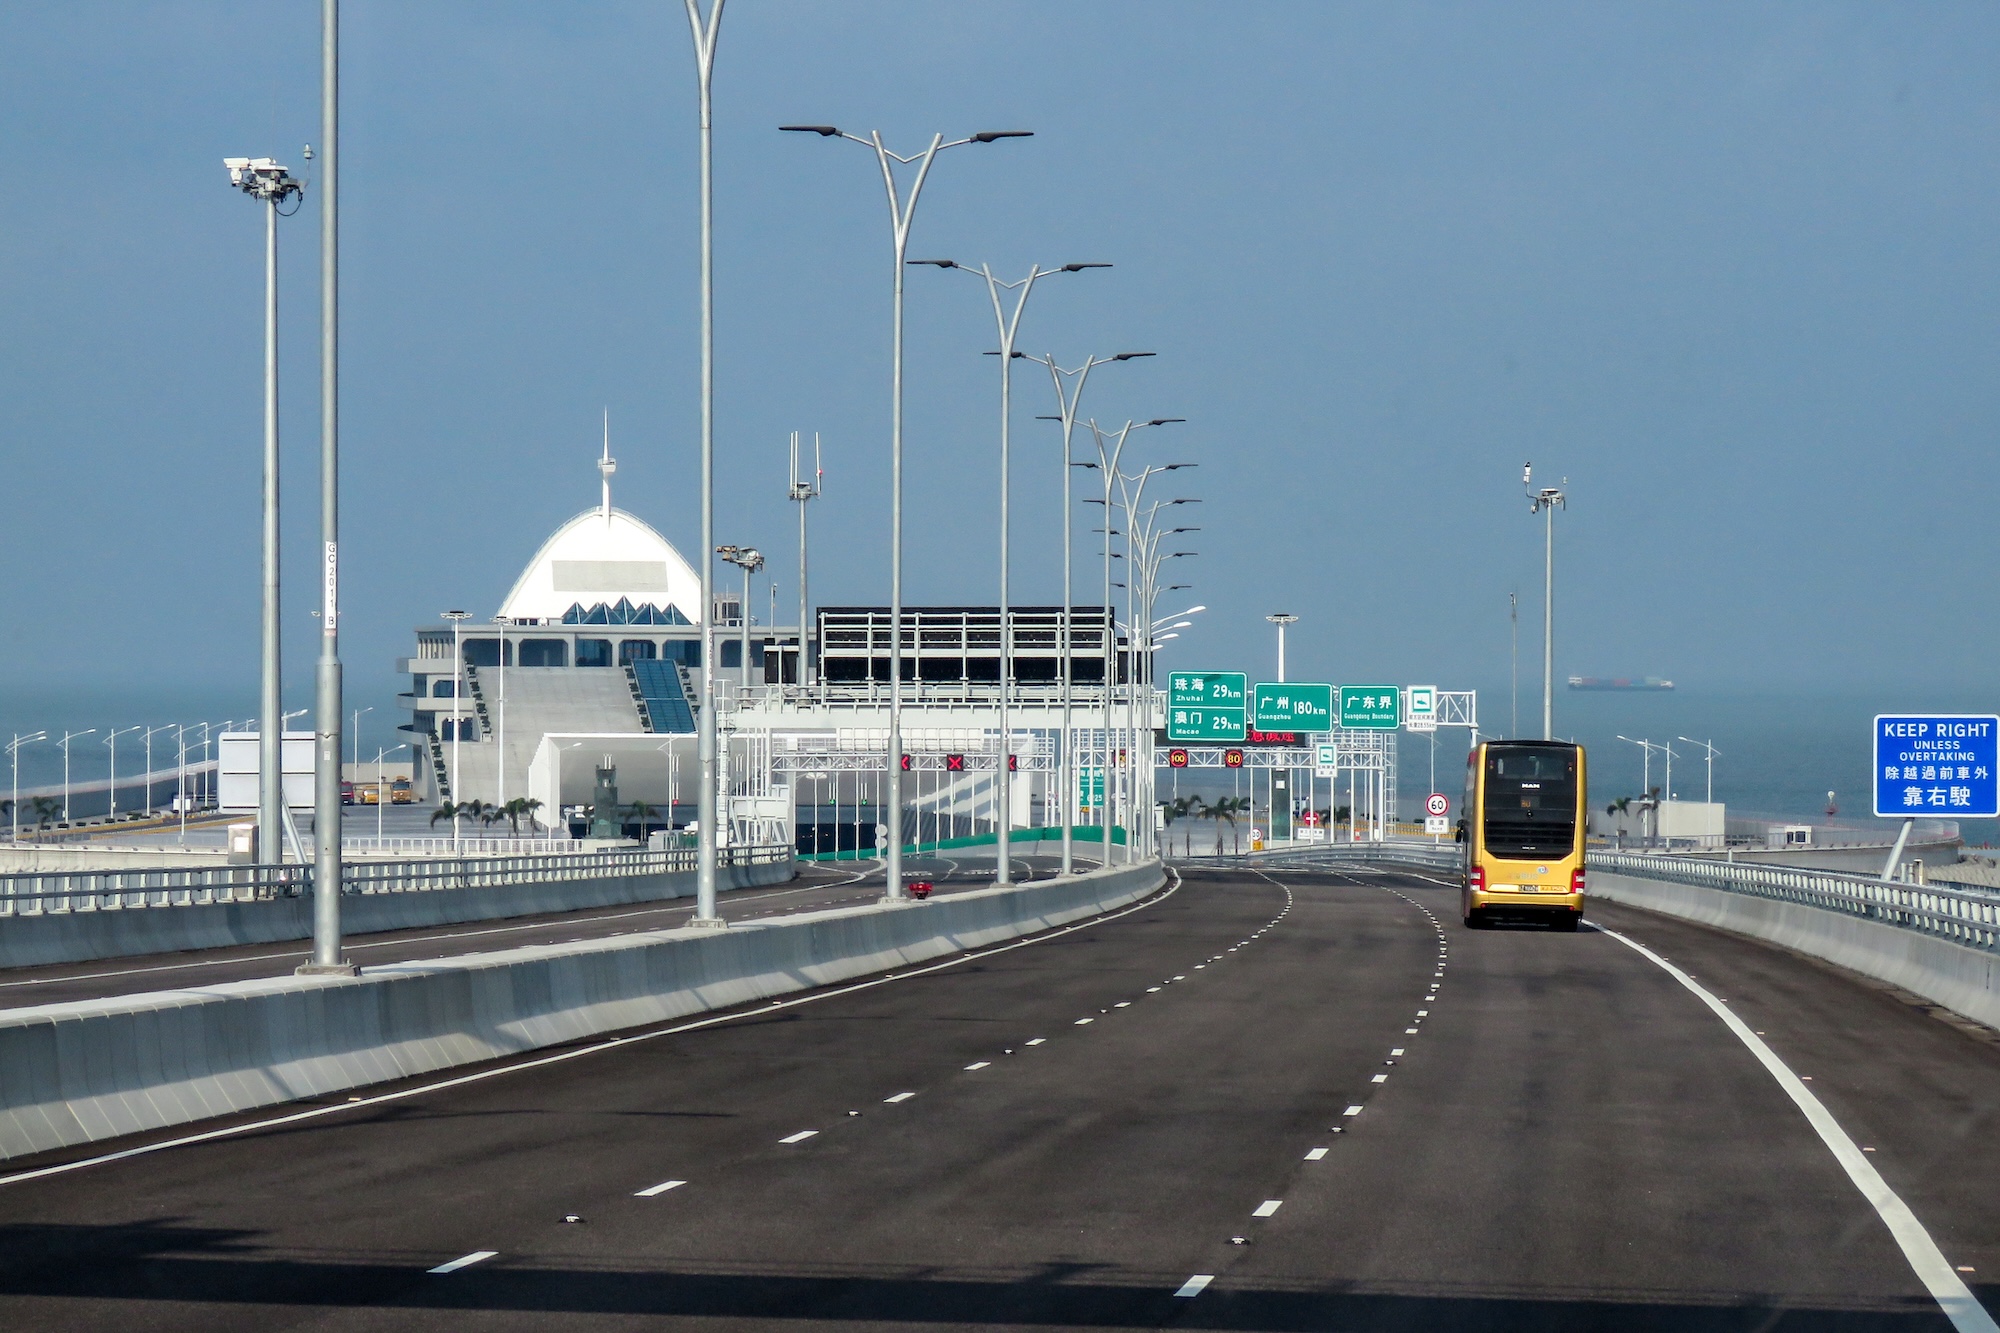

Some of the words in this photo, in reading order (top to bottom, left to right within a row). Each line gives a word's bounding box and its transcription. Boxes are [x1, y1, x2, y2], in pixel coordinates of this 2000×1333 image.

[1174, 678, 1204, 691] 珠海
[1260, 696, 1289, 710] 广州
[1346, 696, 1392, 709] 广东界
[1174, 711, 1202, 724] 澳门
[1344, 712, 1370, 720] Guangdong
[1884, 724, 1928, 737] KEEP
[1936, 724, 1990, 737] RIGHT
[1914, 740, 1960, 750] UNLESS
[1228, 754, 1240, 763] 80
[1900, 752, 1975, 761] OVERTAKING
[1885, 766, 1988, 780] 除越過前車外
[1903, 786, 1970, 806] 靠右駛
[1431, 800, 1444, 810] 60
